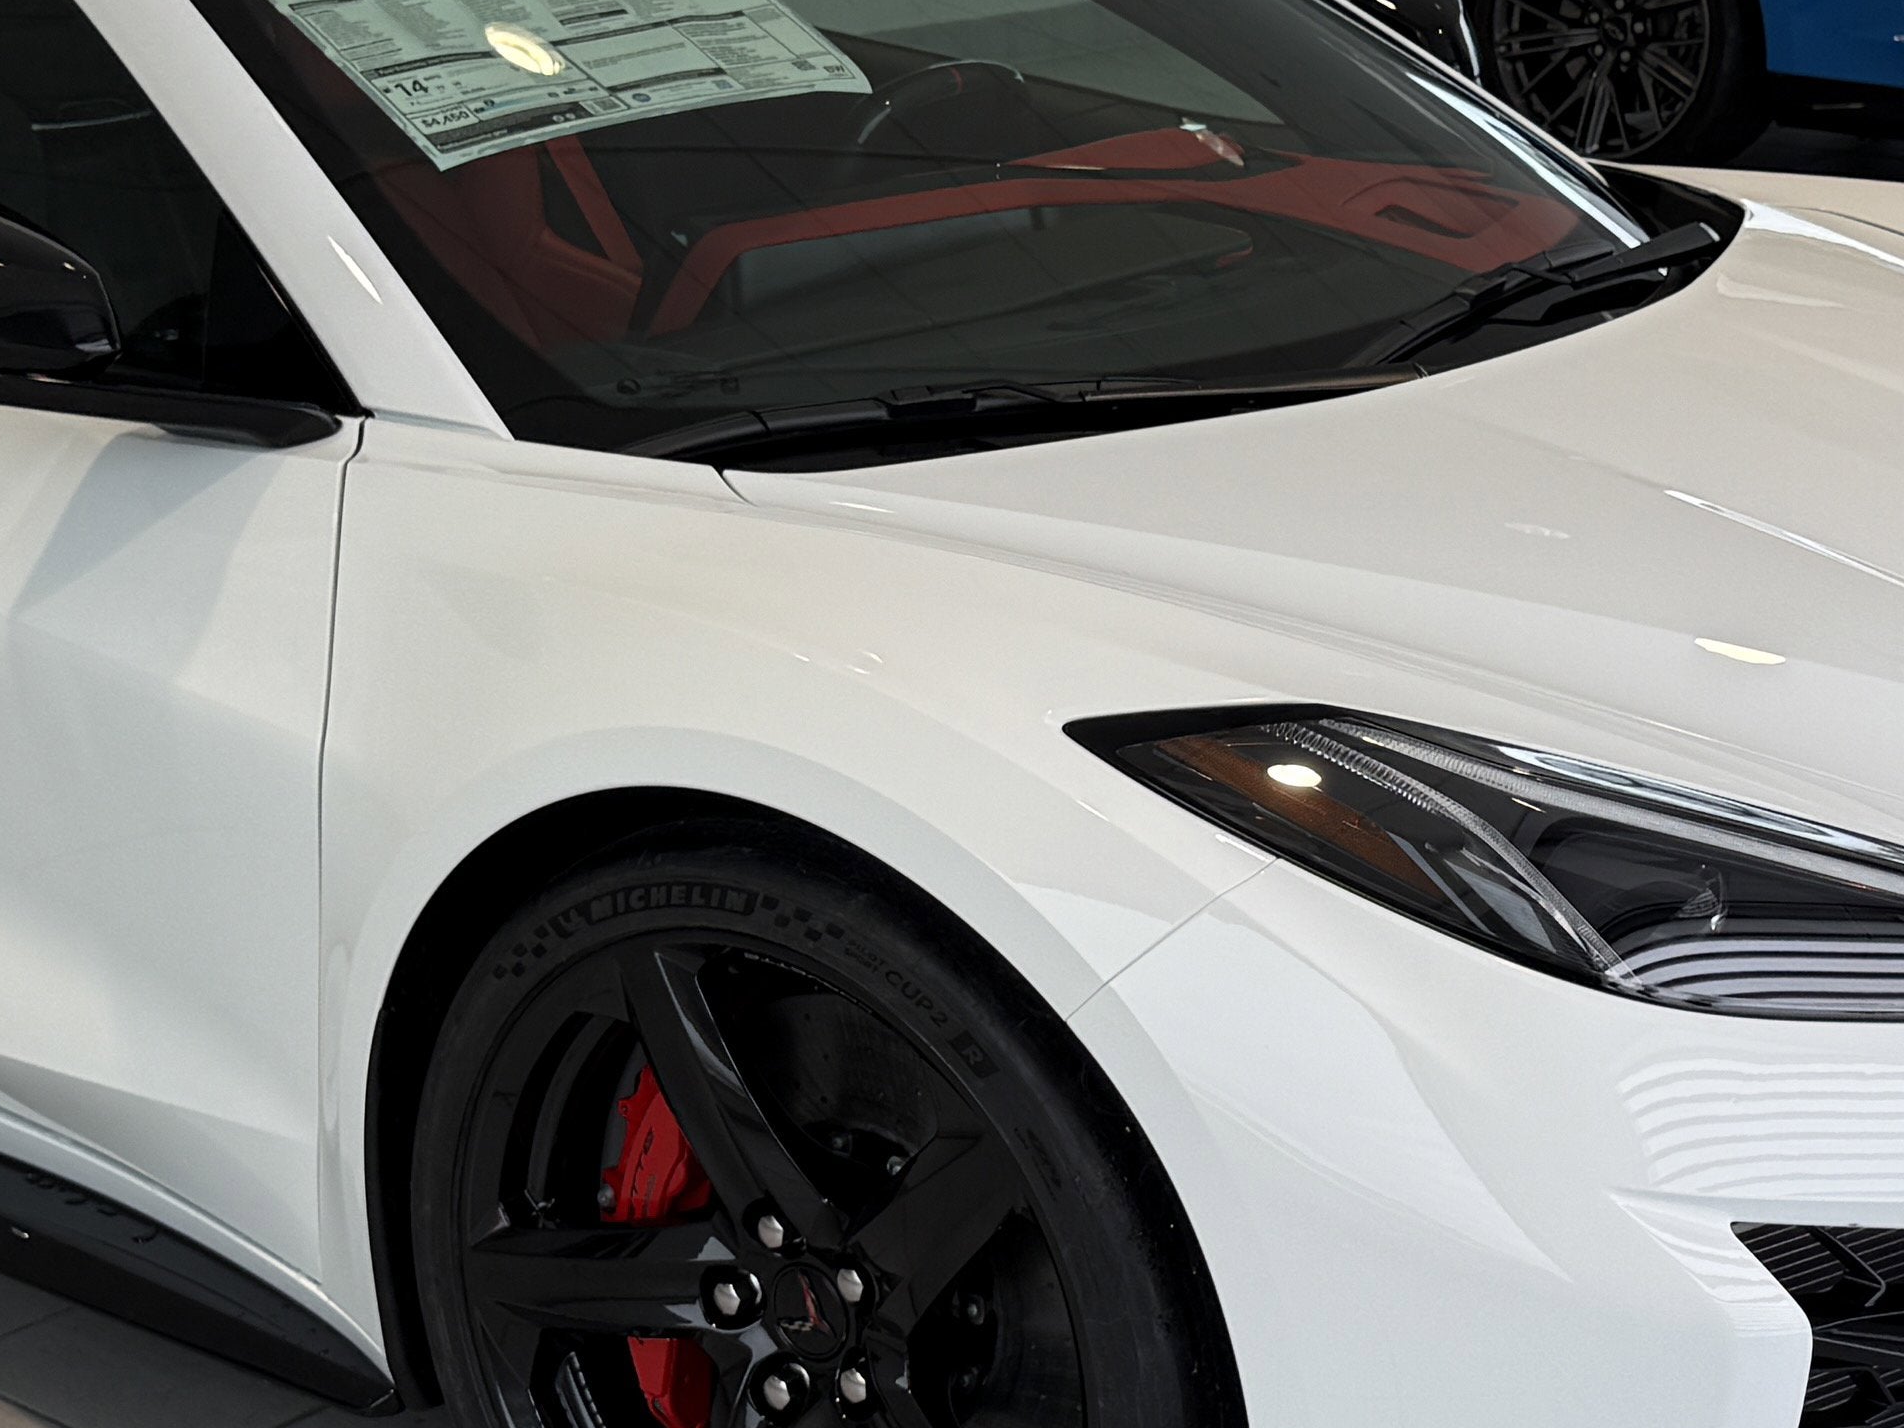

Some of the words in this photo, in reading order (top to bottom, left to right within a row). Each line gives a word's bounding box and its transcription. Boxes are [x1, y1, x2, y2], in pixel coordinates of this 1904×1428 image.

[395, 80, 429, 97] 14
[589, 883, 753, 924] MICHELIN
[885, 969, 934, 1013] CUP
[930, 1011, 948, 1028] 2
